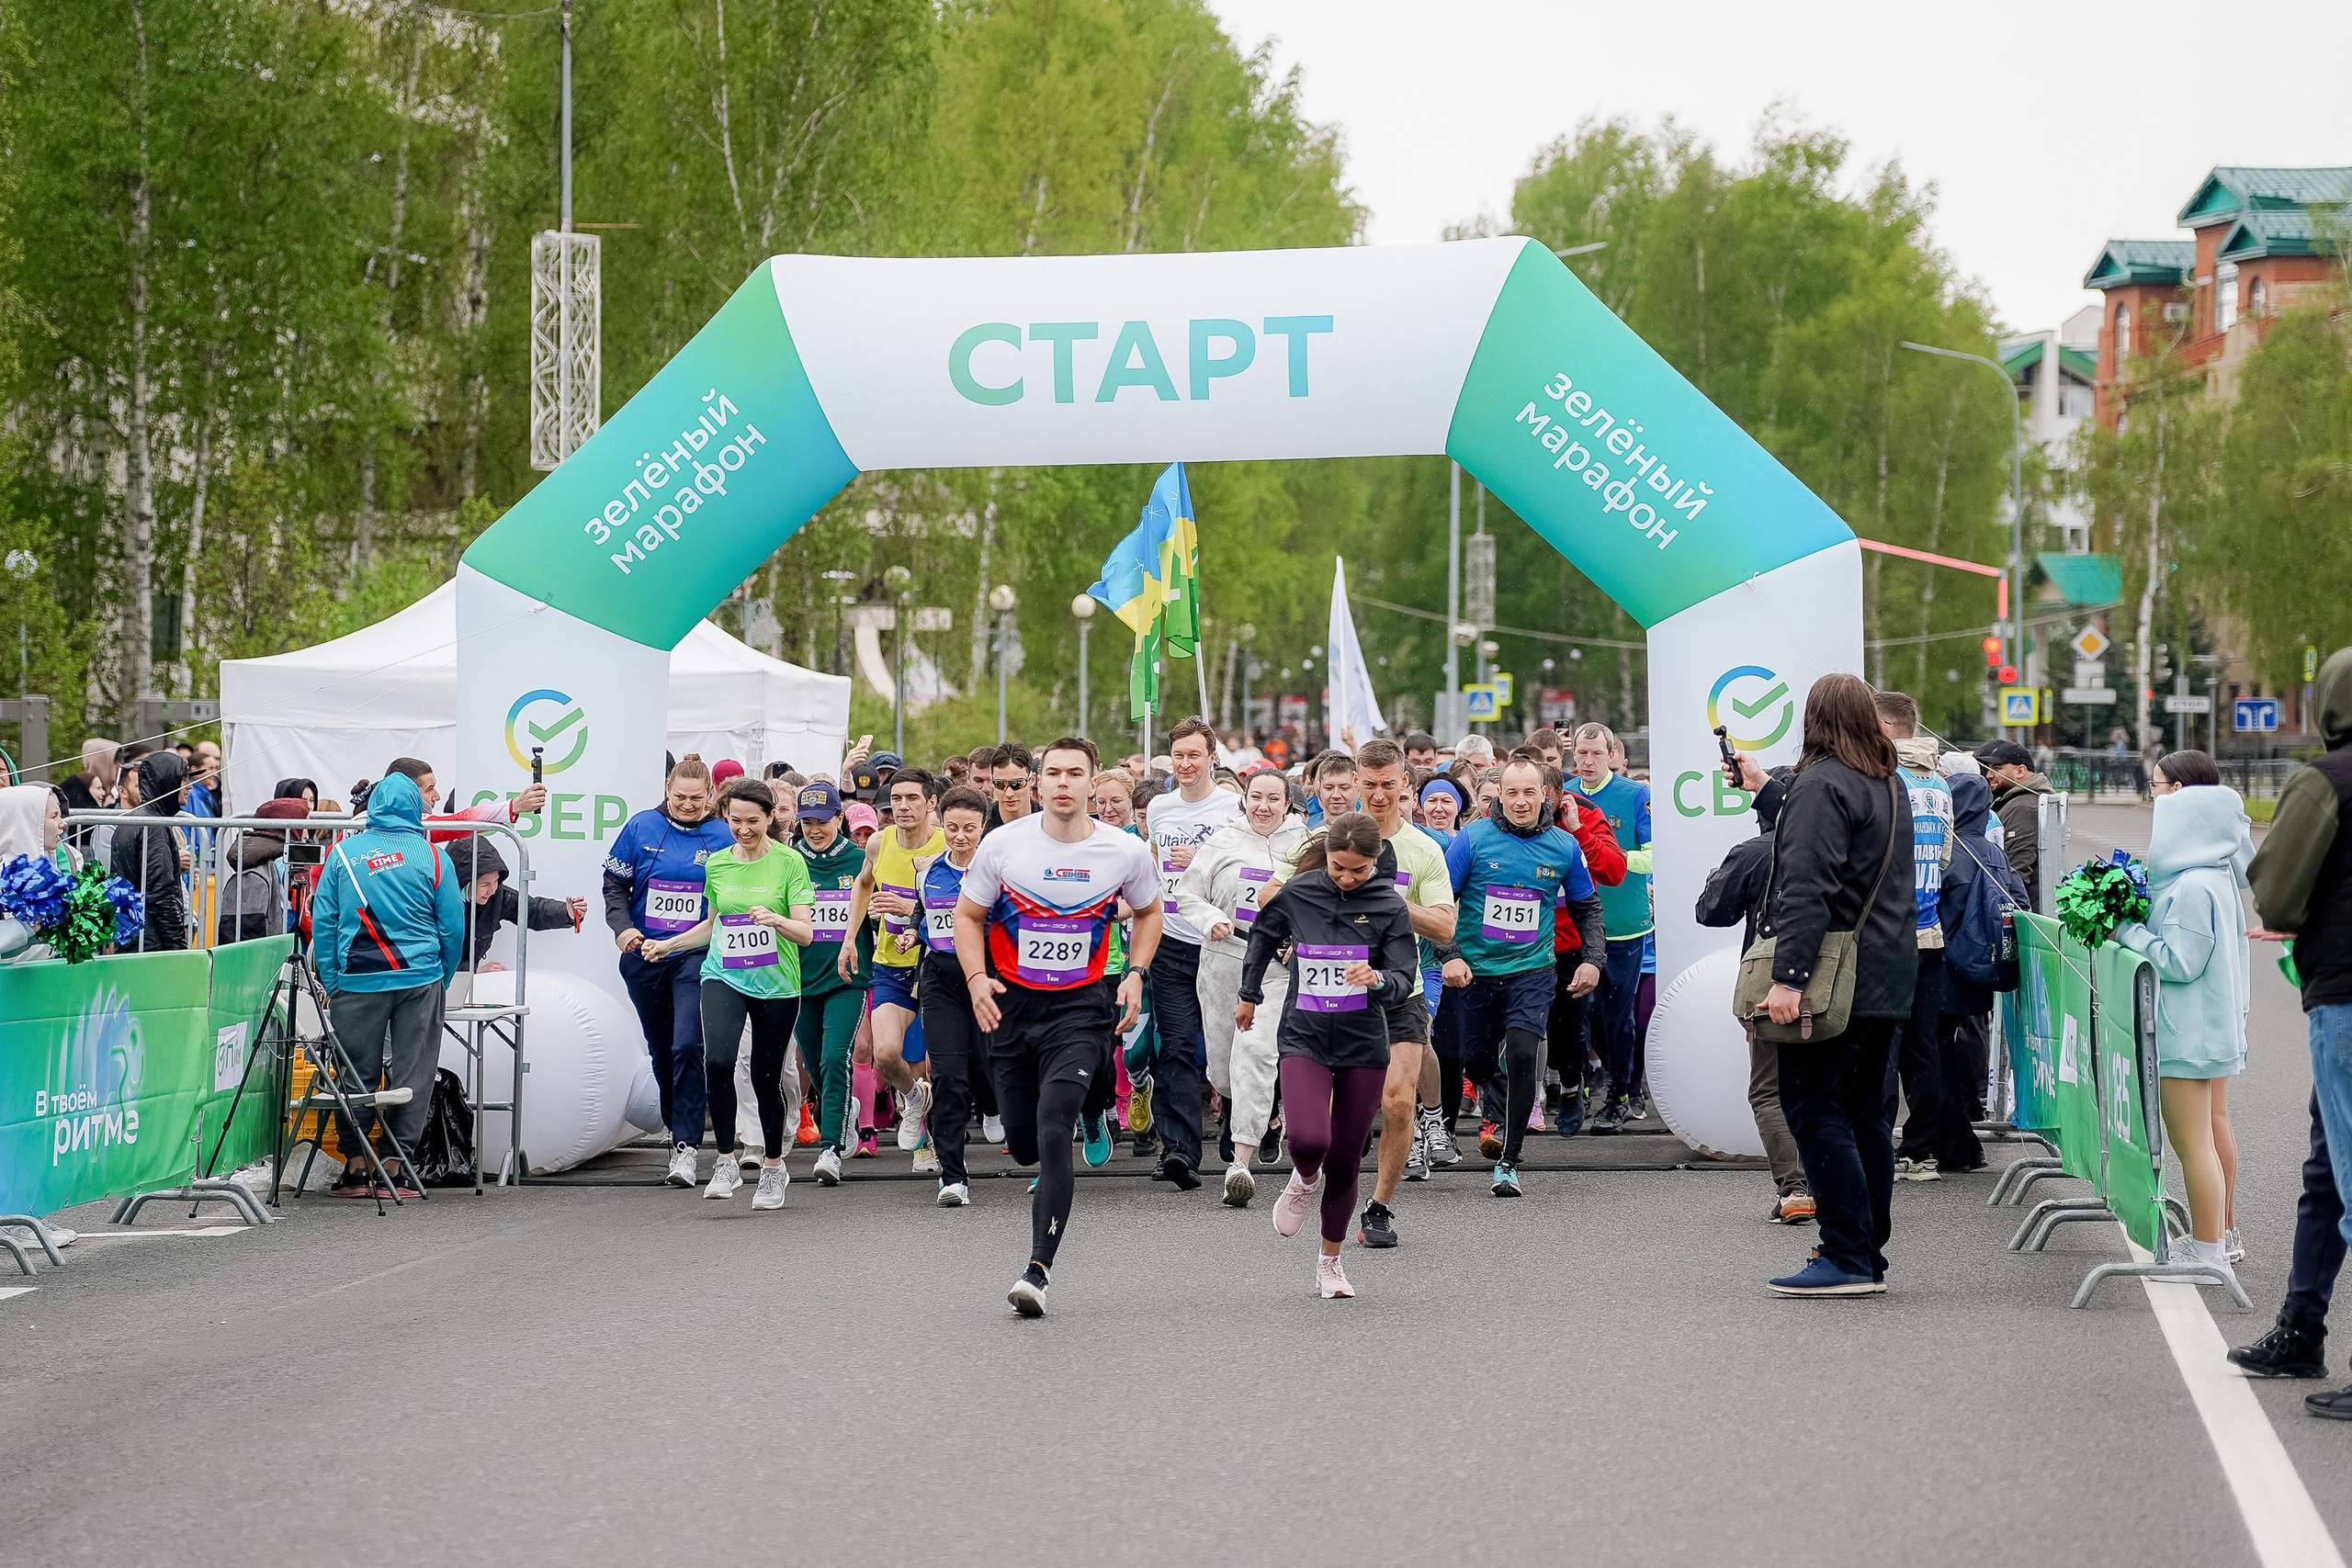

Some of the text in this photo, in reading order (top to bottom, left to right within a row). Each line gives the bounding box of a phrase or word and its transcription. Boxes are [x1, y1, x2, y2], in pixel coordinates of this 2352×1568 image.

[948, 314, 1334, 407] СТАРТ
[1542, 371, 1716, 522] зелёный
[582, 388, 741, 547] зелёный
[1514, 400, 1679, 550] марафон
[608, 423, 768, 576] марафон
[1673, 765, 1770, 818] СБ
[1159, 834, 1191, 847] Utair
[350, 848, 384, 867] RACE
[371, 854, 399, 867] TIME
[655, 897, 695, 912] 2000
[1492, 904, 1533, 923] 2151
[810, 908, 848, 922] 2186
[933, 914, 953, 930] 20
[727, 931, 769, 949] 2100
[1028, 940, 1082, 961] 2289
[1306, 967, 1345, 986] 215
[35, 1082, 97, 1117] В твоём
[52, 1108, 140, 1168] ритме
